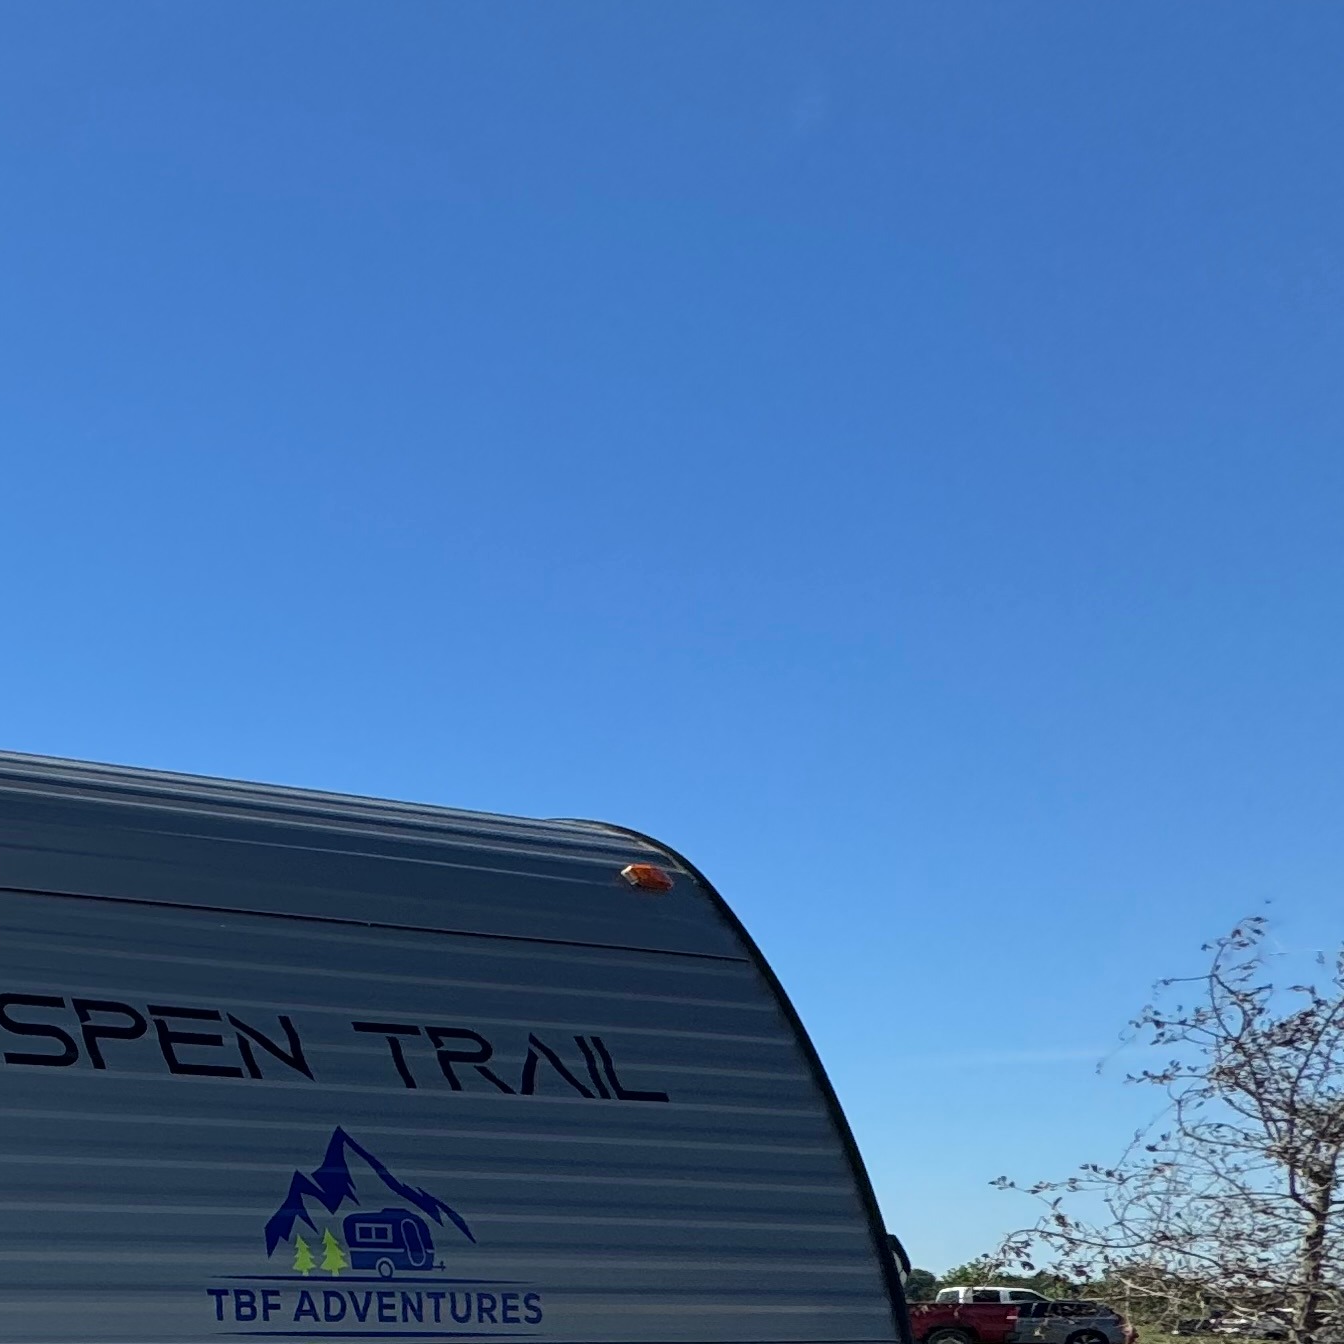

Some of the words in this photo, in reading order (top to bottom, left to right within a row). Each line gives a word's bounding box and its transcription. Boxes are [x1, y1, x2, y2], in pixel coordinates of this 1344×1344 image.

[351, 1020, 671, 1104] TRAIL
[206, 1288, 282, 1322] TBF
[292, 1290, 544, 1325] ADVENTURES
